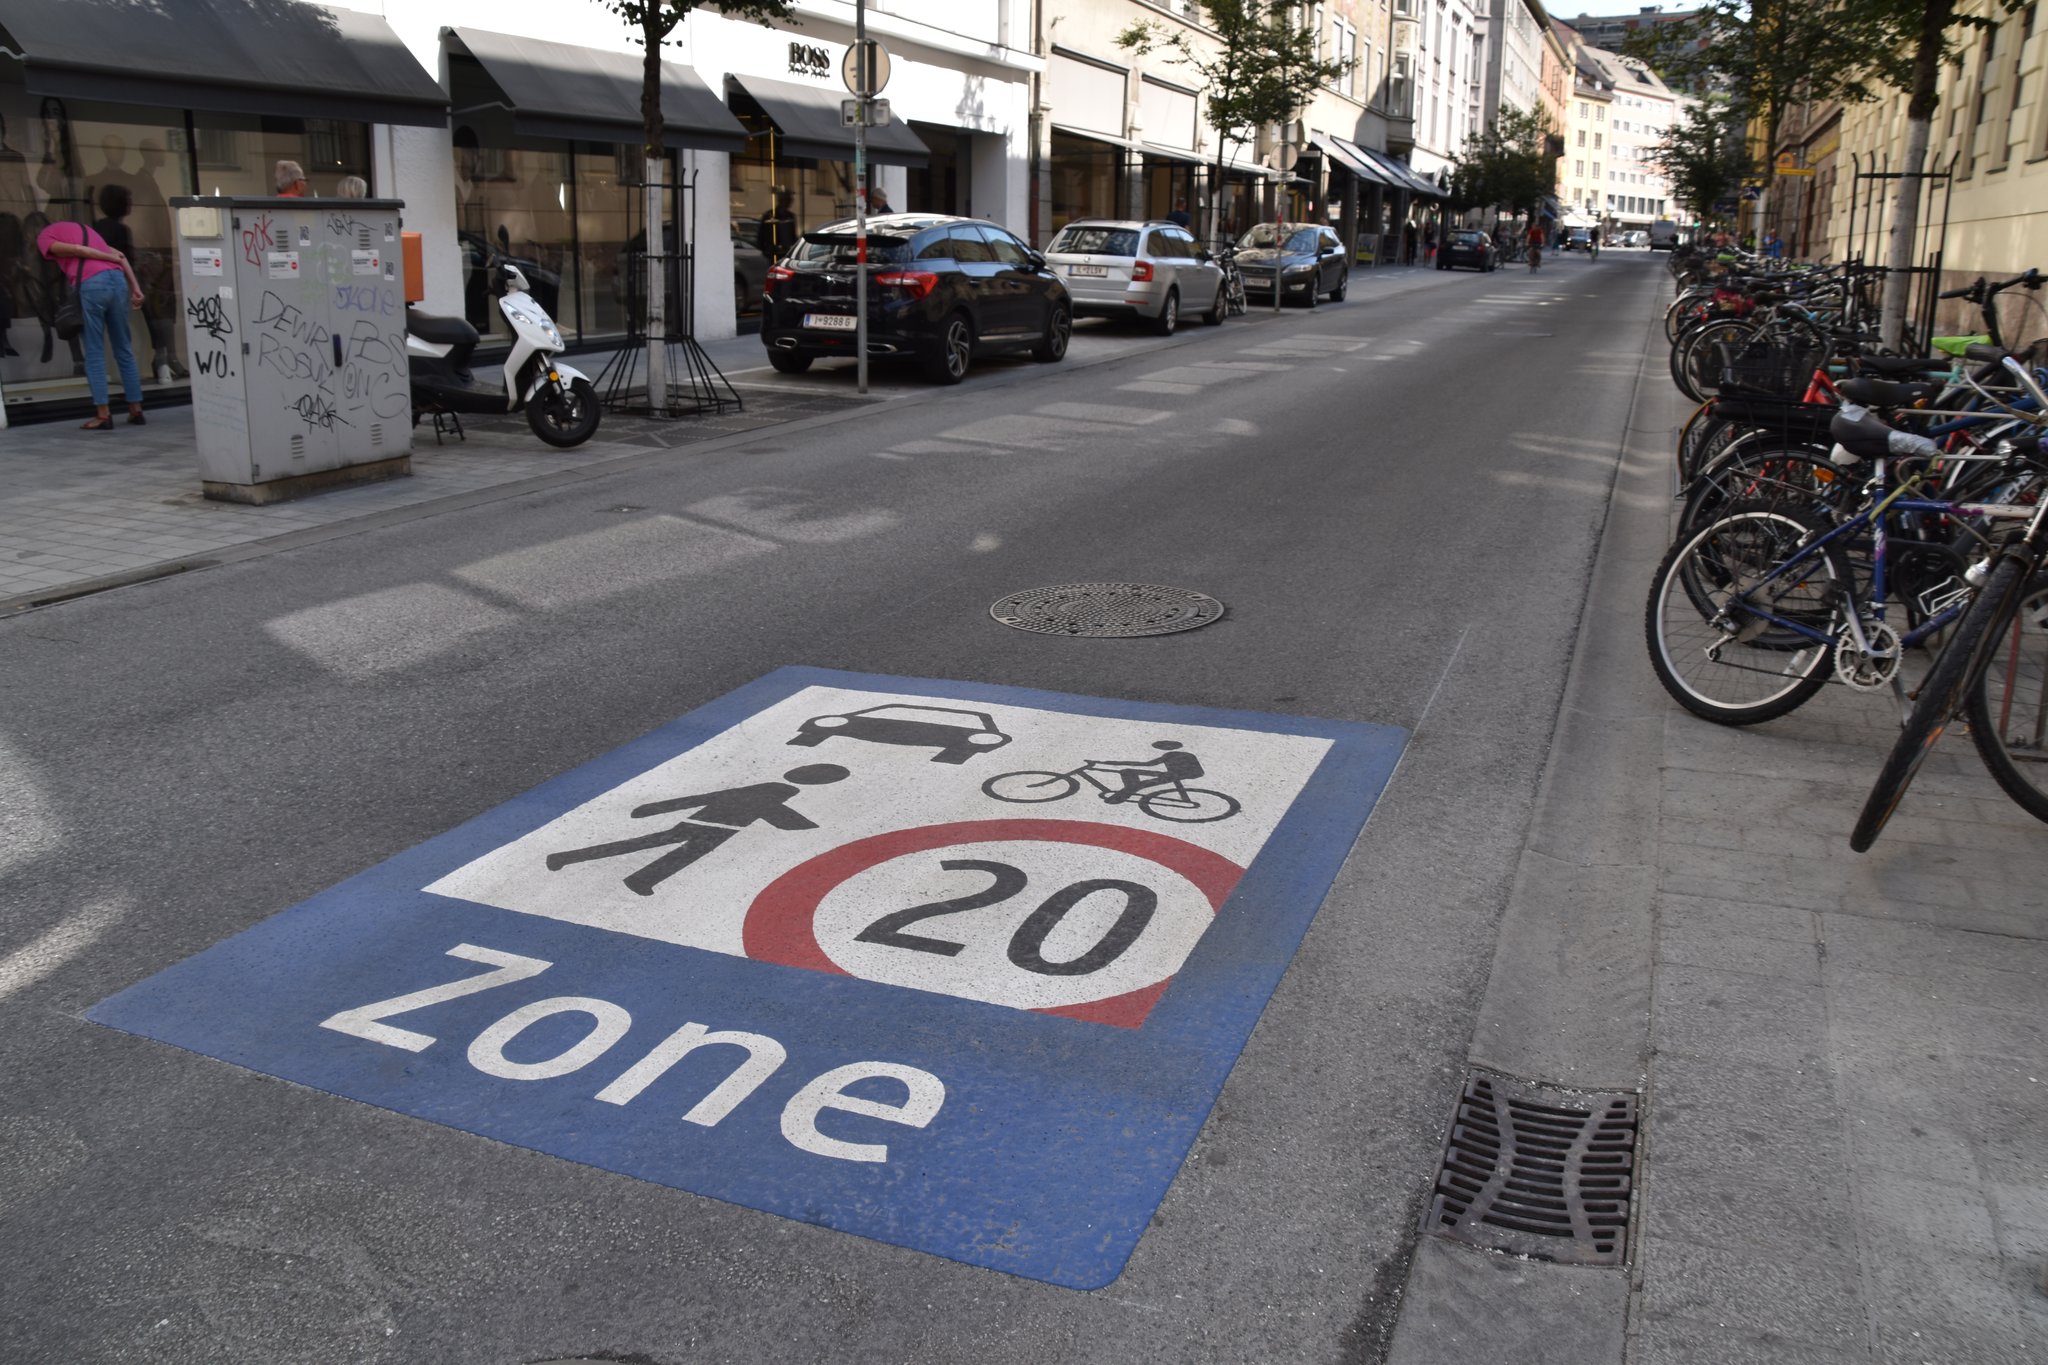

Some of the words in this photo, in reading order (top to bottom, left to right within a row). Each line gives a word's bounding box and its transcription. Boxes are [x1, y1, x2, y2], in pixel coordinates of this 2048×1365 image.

[788, 41, 831, 70] BOSS
[854, 860, 1158, 976] 20
[318, 943, 946, 1164] zone
